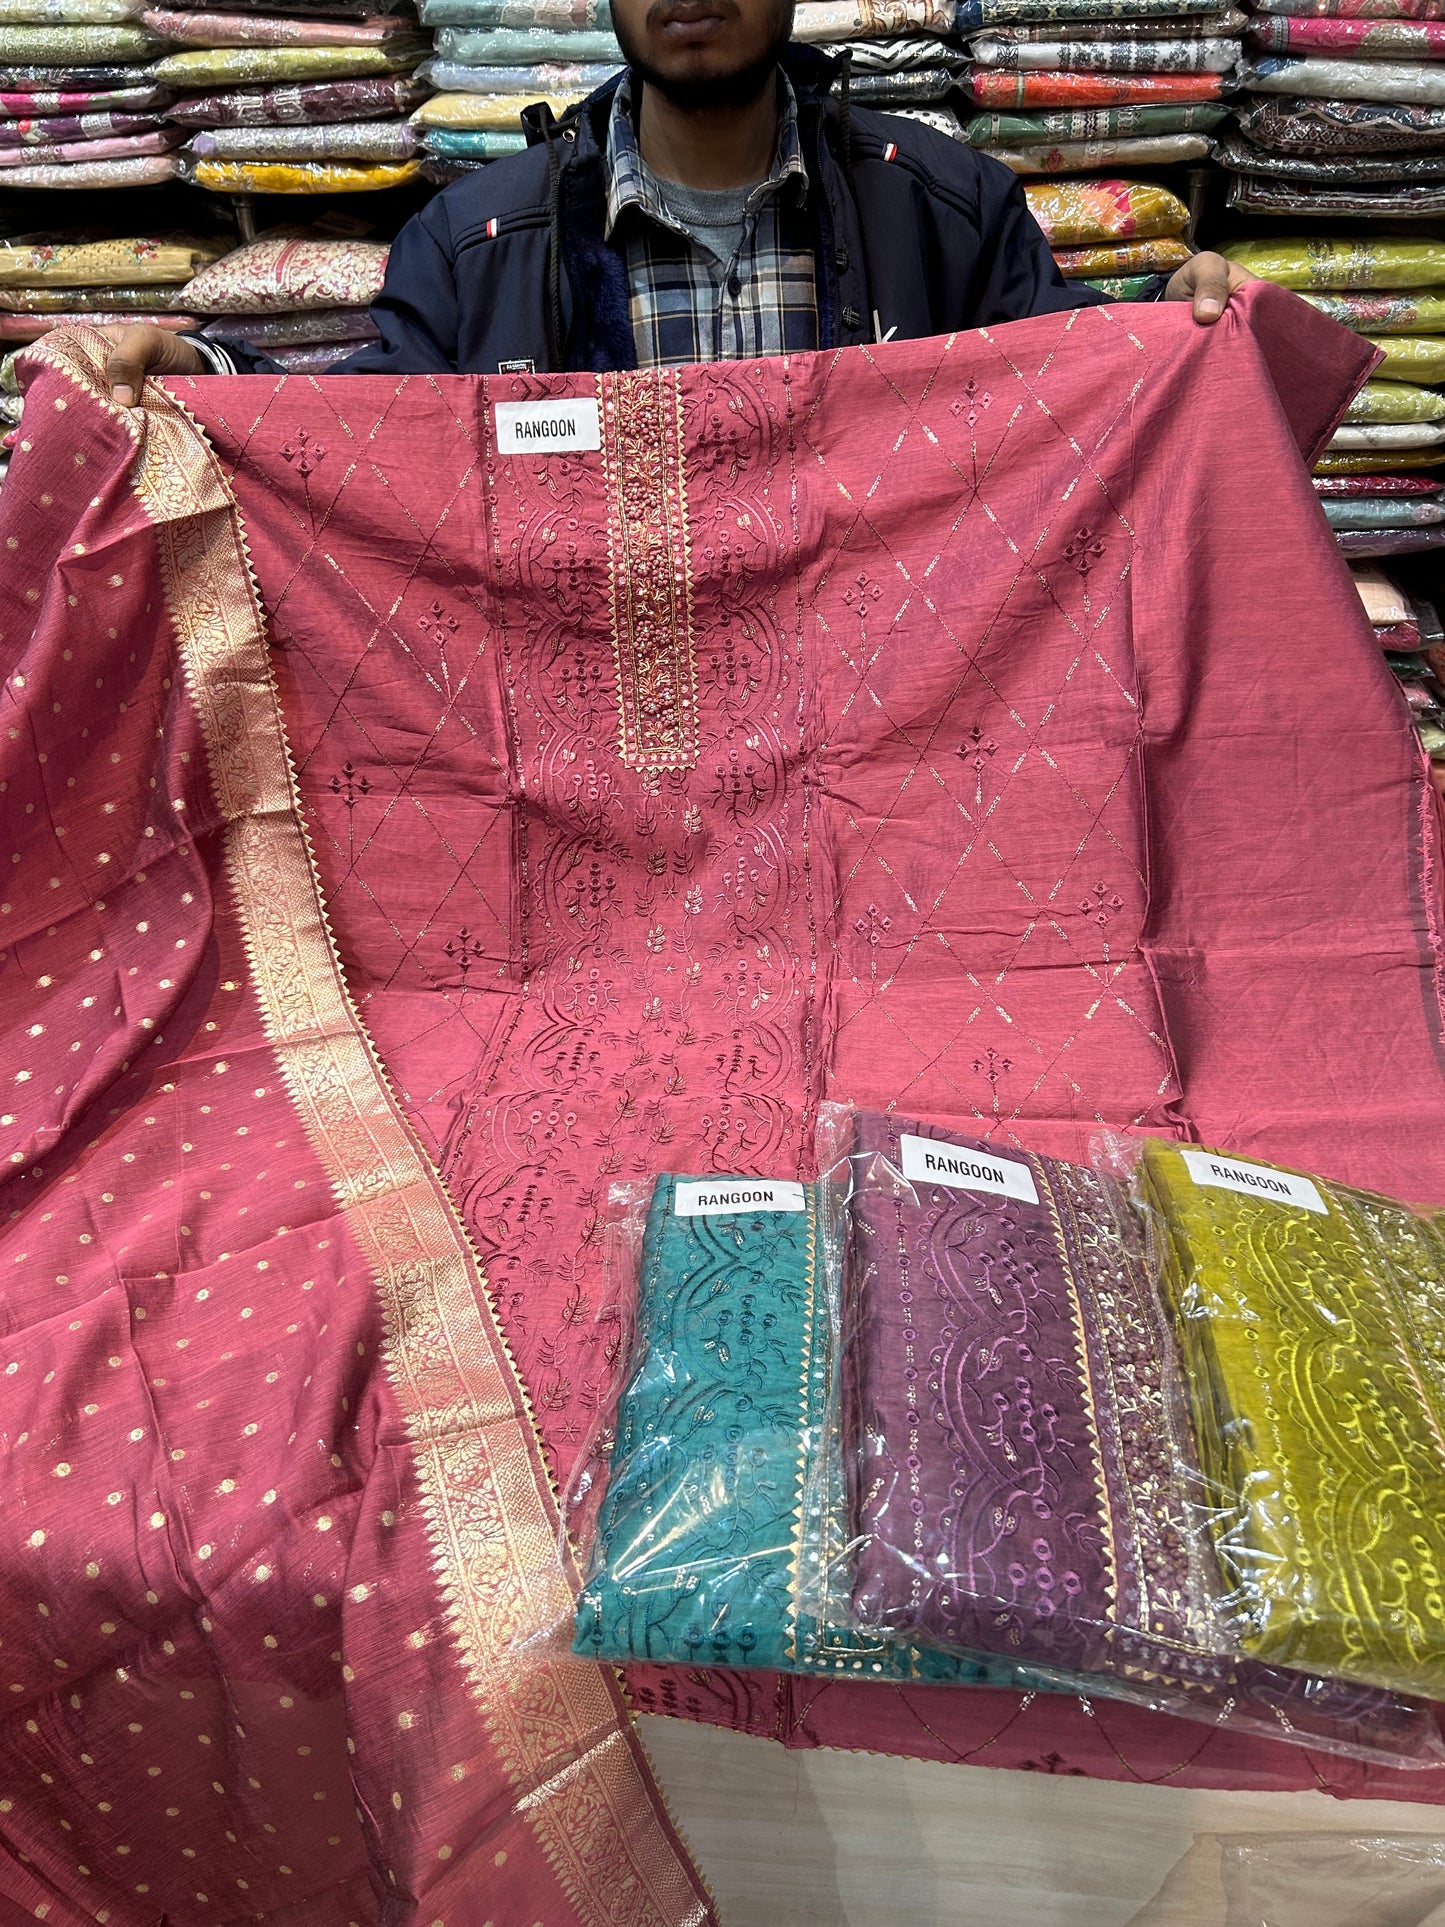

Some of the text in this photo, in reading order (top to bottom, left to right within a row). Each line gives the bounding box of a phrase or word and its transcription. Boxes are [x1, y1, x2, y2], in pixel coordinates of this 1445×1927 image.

[515, 418, 576, 439] RANGOON
[925, 1153, 1005, 1184] RANGOON
[1210, 1164, 1292, 1195] RANGOON
[698, 1191, 774, 1206] RANGOON
